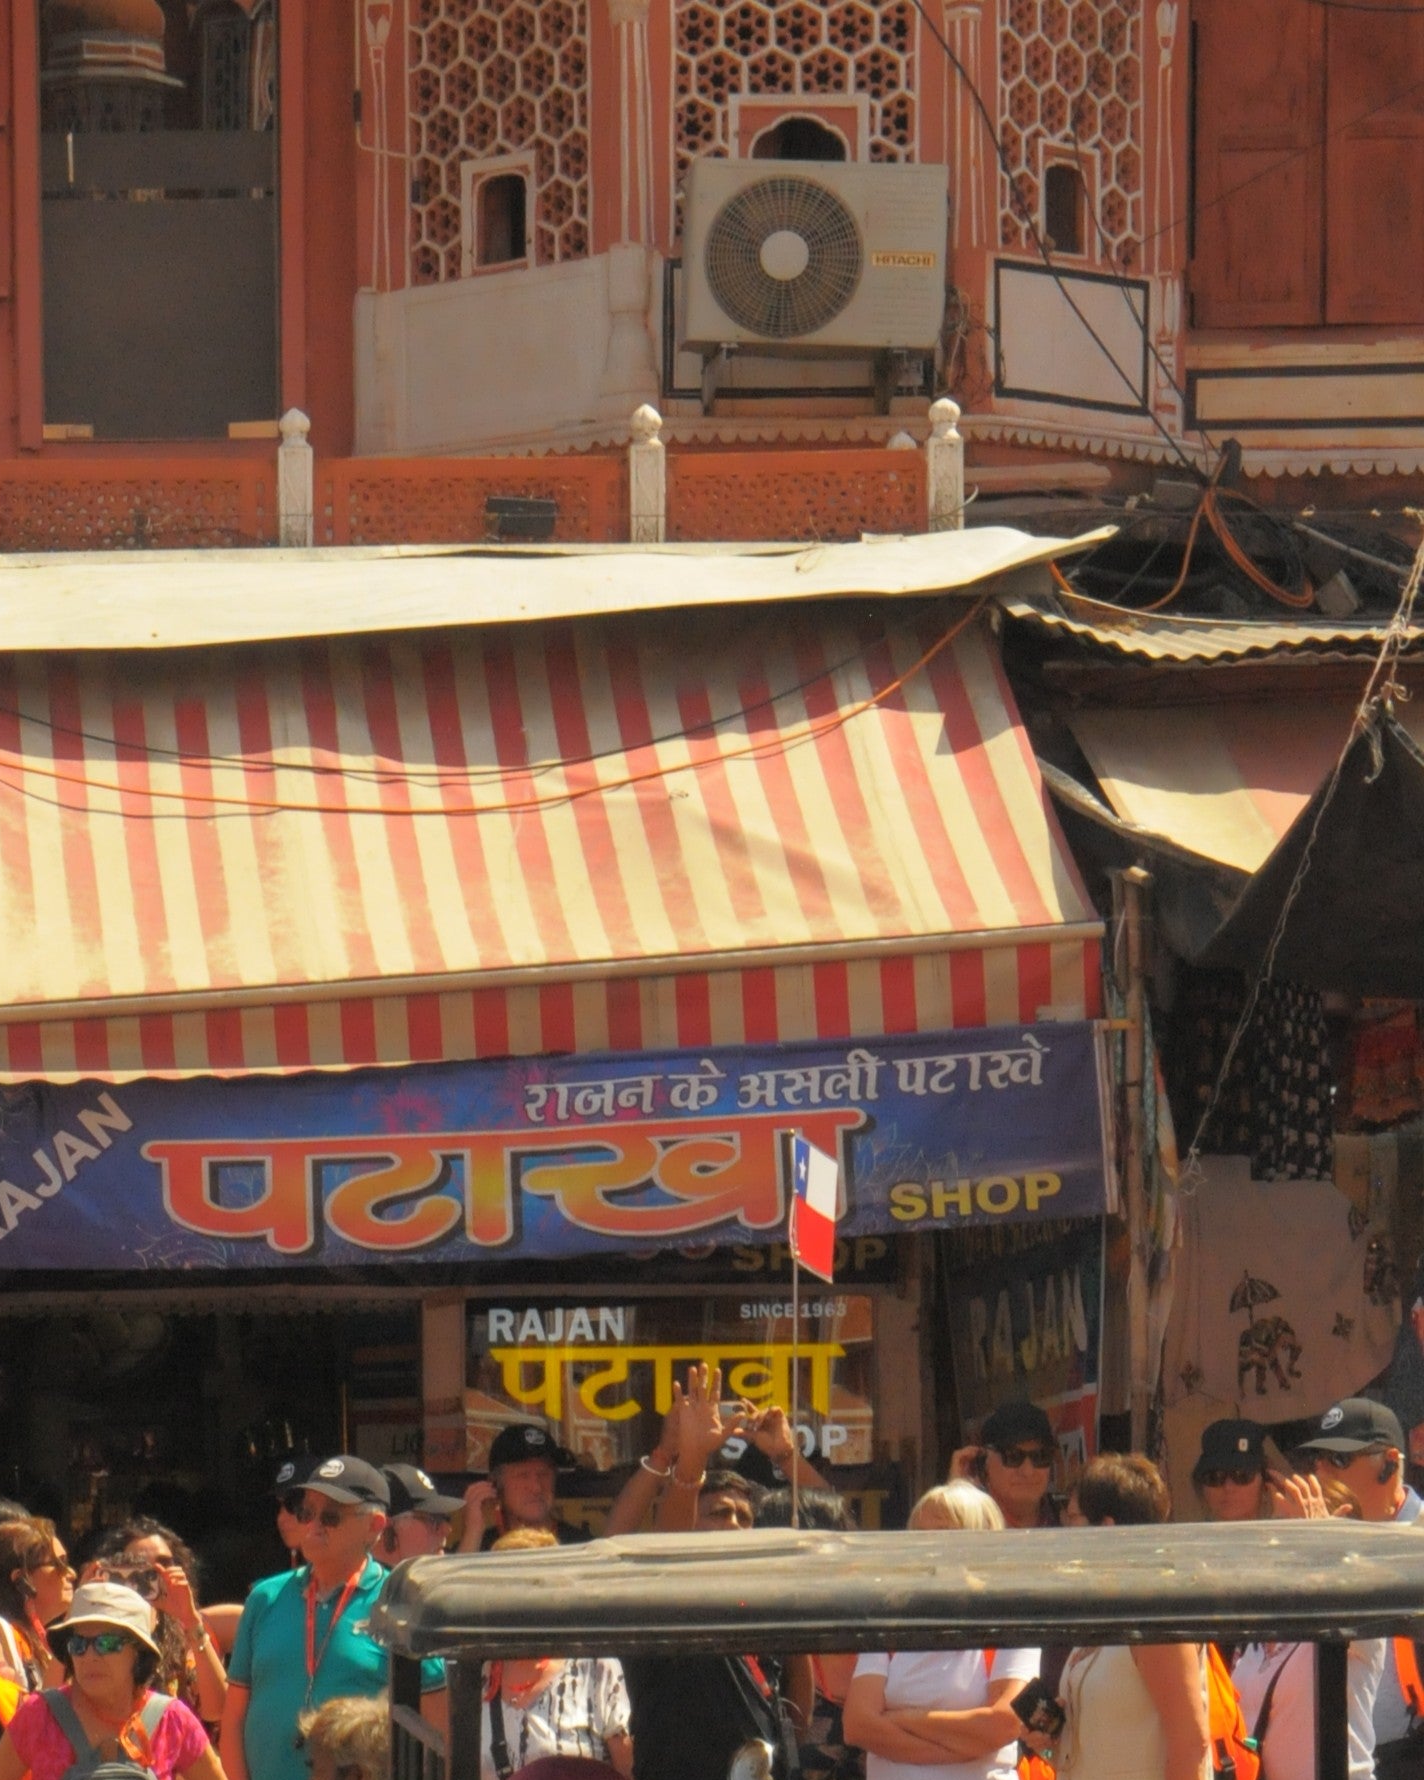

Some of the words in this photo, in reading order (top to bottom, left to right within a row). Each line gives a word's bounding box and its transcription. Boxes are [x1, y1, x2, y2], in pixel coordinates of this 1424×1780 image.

[875, 254, 931, 267] HITACHI
[668, 1058, 726, 1111] के
[736, 1047, 886, 1109] असली
[889, 1171, 1063, 1222] SHOP
[488, 1307, 624, 1342] RAJAN
[740, 1302, 795, 1319] SINCE
